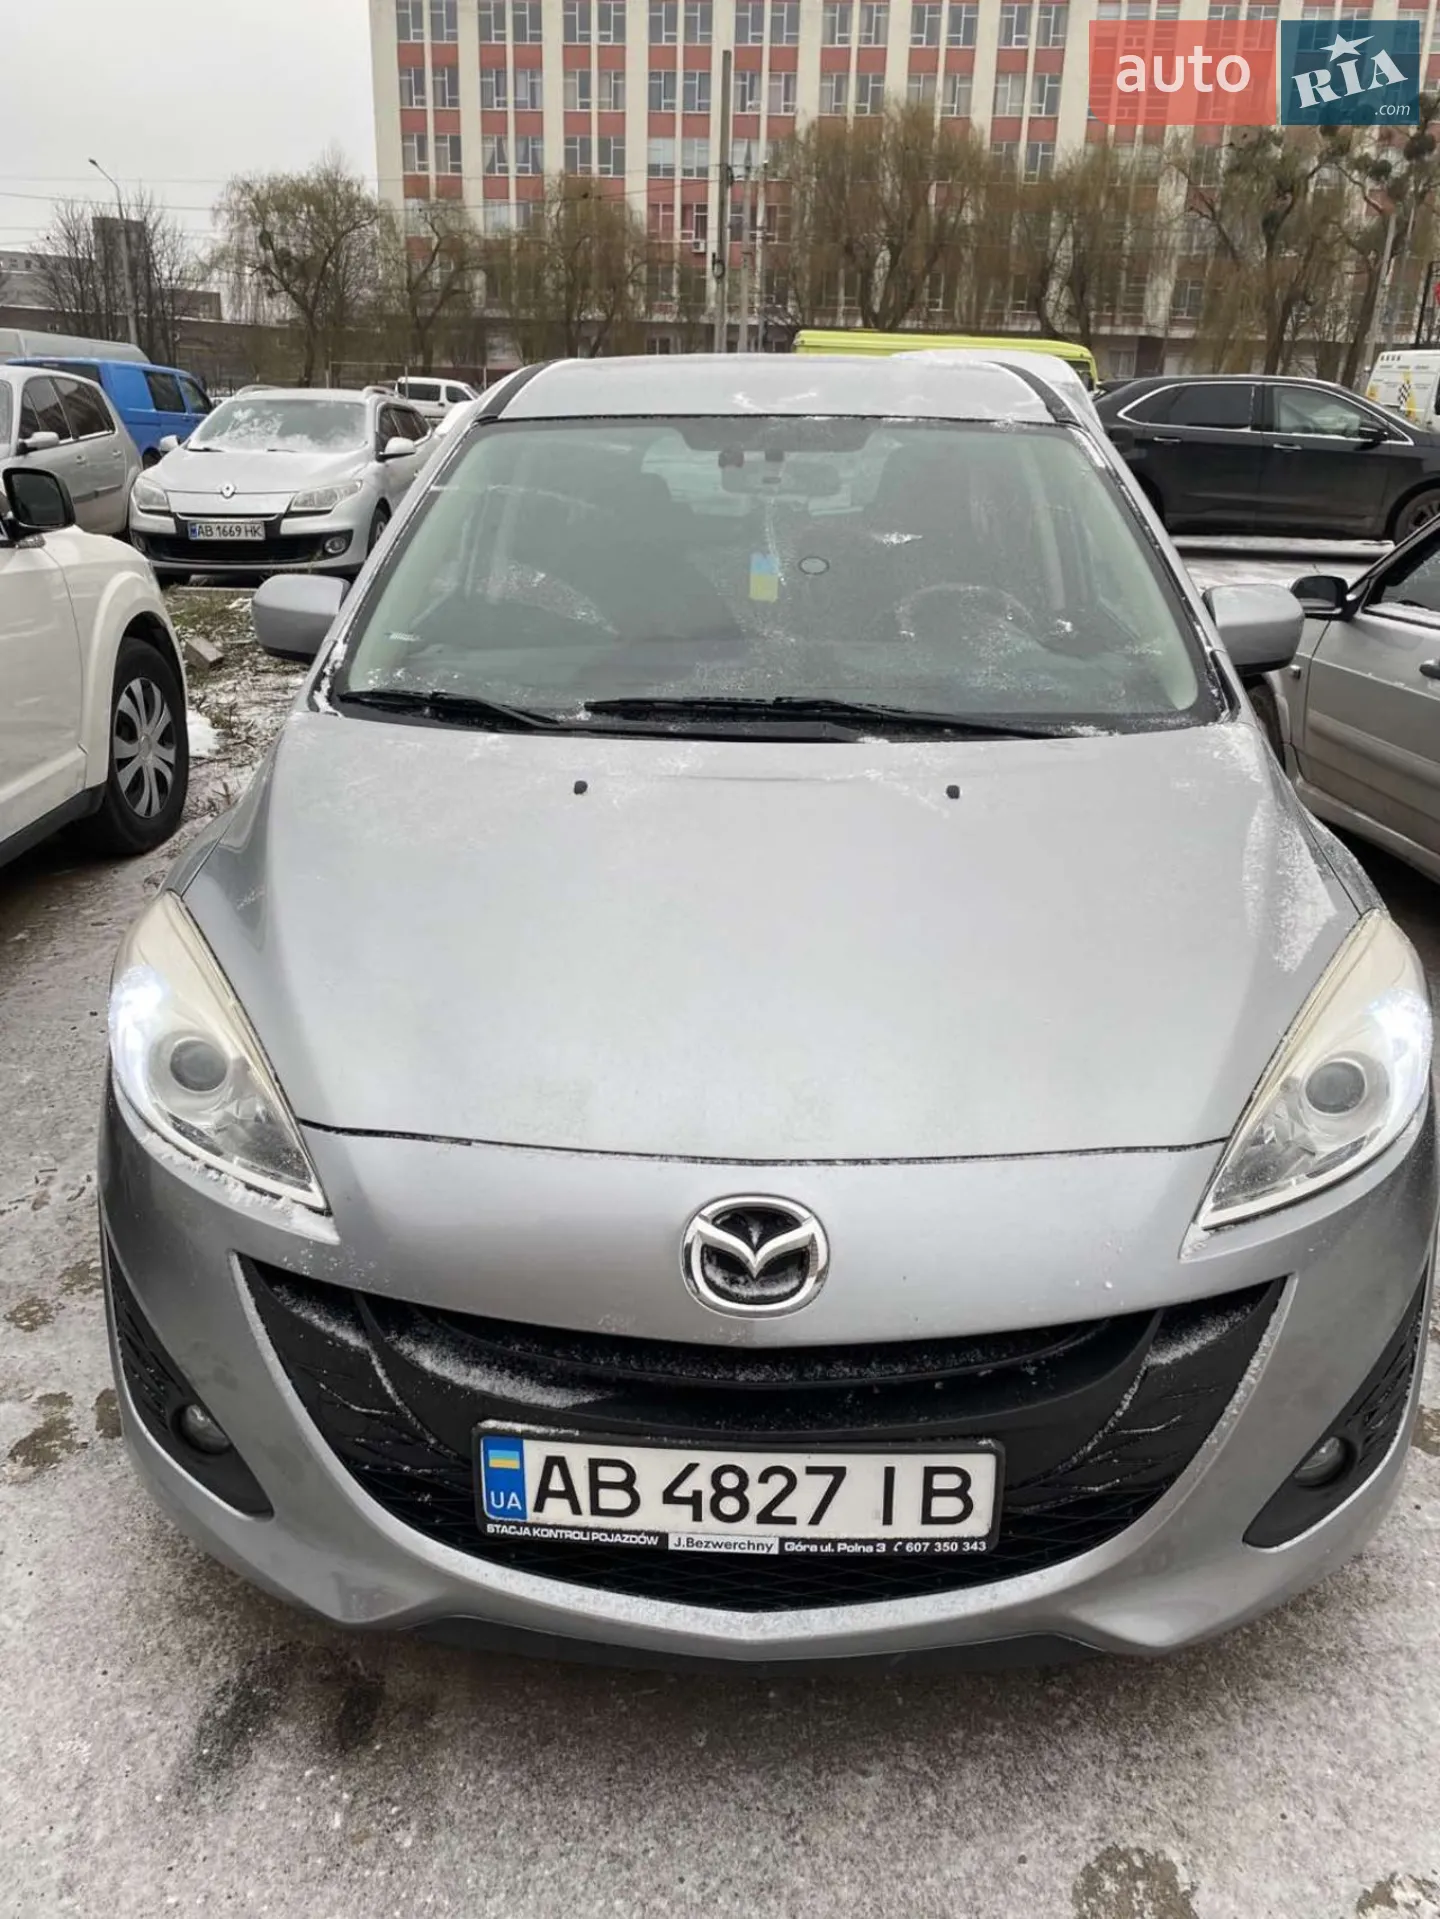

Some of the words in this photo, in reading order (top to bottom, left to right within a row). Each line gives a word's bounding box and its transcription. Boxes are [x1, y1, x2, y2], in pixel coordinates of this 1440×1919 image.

[198, 525, 214, 537] AB
[216, 525, 242, 537] 1669
[244, 525, 263, 537] HK
[533, 1455, 640, 1518] AB
[662, 1462, 847, 1526] 4827
[882, 1466, 974, 1526] IB
[490, 1491, 522, 1510] UA
[487, 1523, 531, 1537] STACJA
[532, 1527, 590, 1541] KONTROLI
[591, 1532, 659, 1546] POJAZDÓW
[784, 1541, 818, 1552] Góra
[819, 1542, 834, 1553] ul.
[837, 1542, 874, 1553] Polna
[875, 1542, 886, 1553] 3
[905, 1541, 930, 1553] 607
[934, 1541, 958, 1552] 350
[962, 1541, 987, 1551] 343
